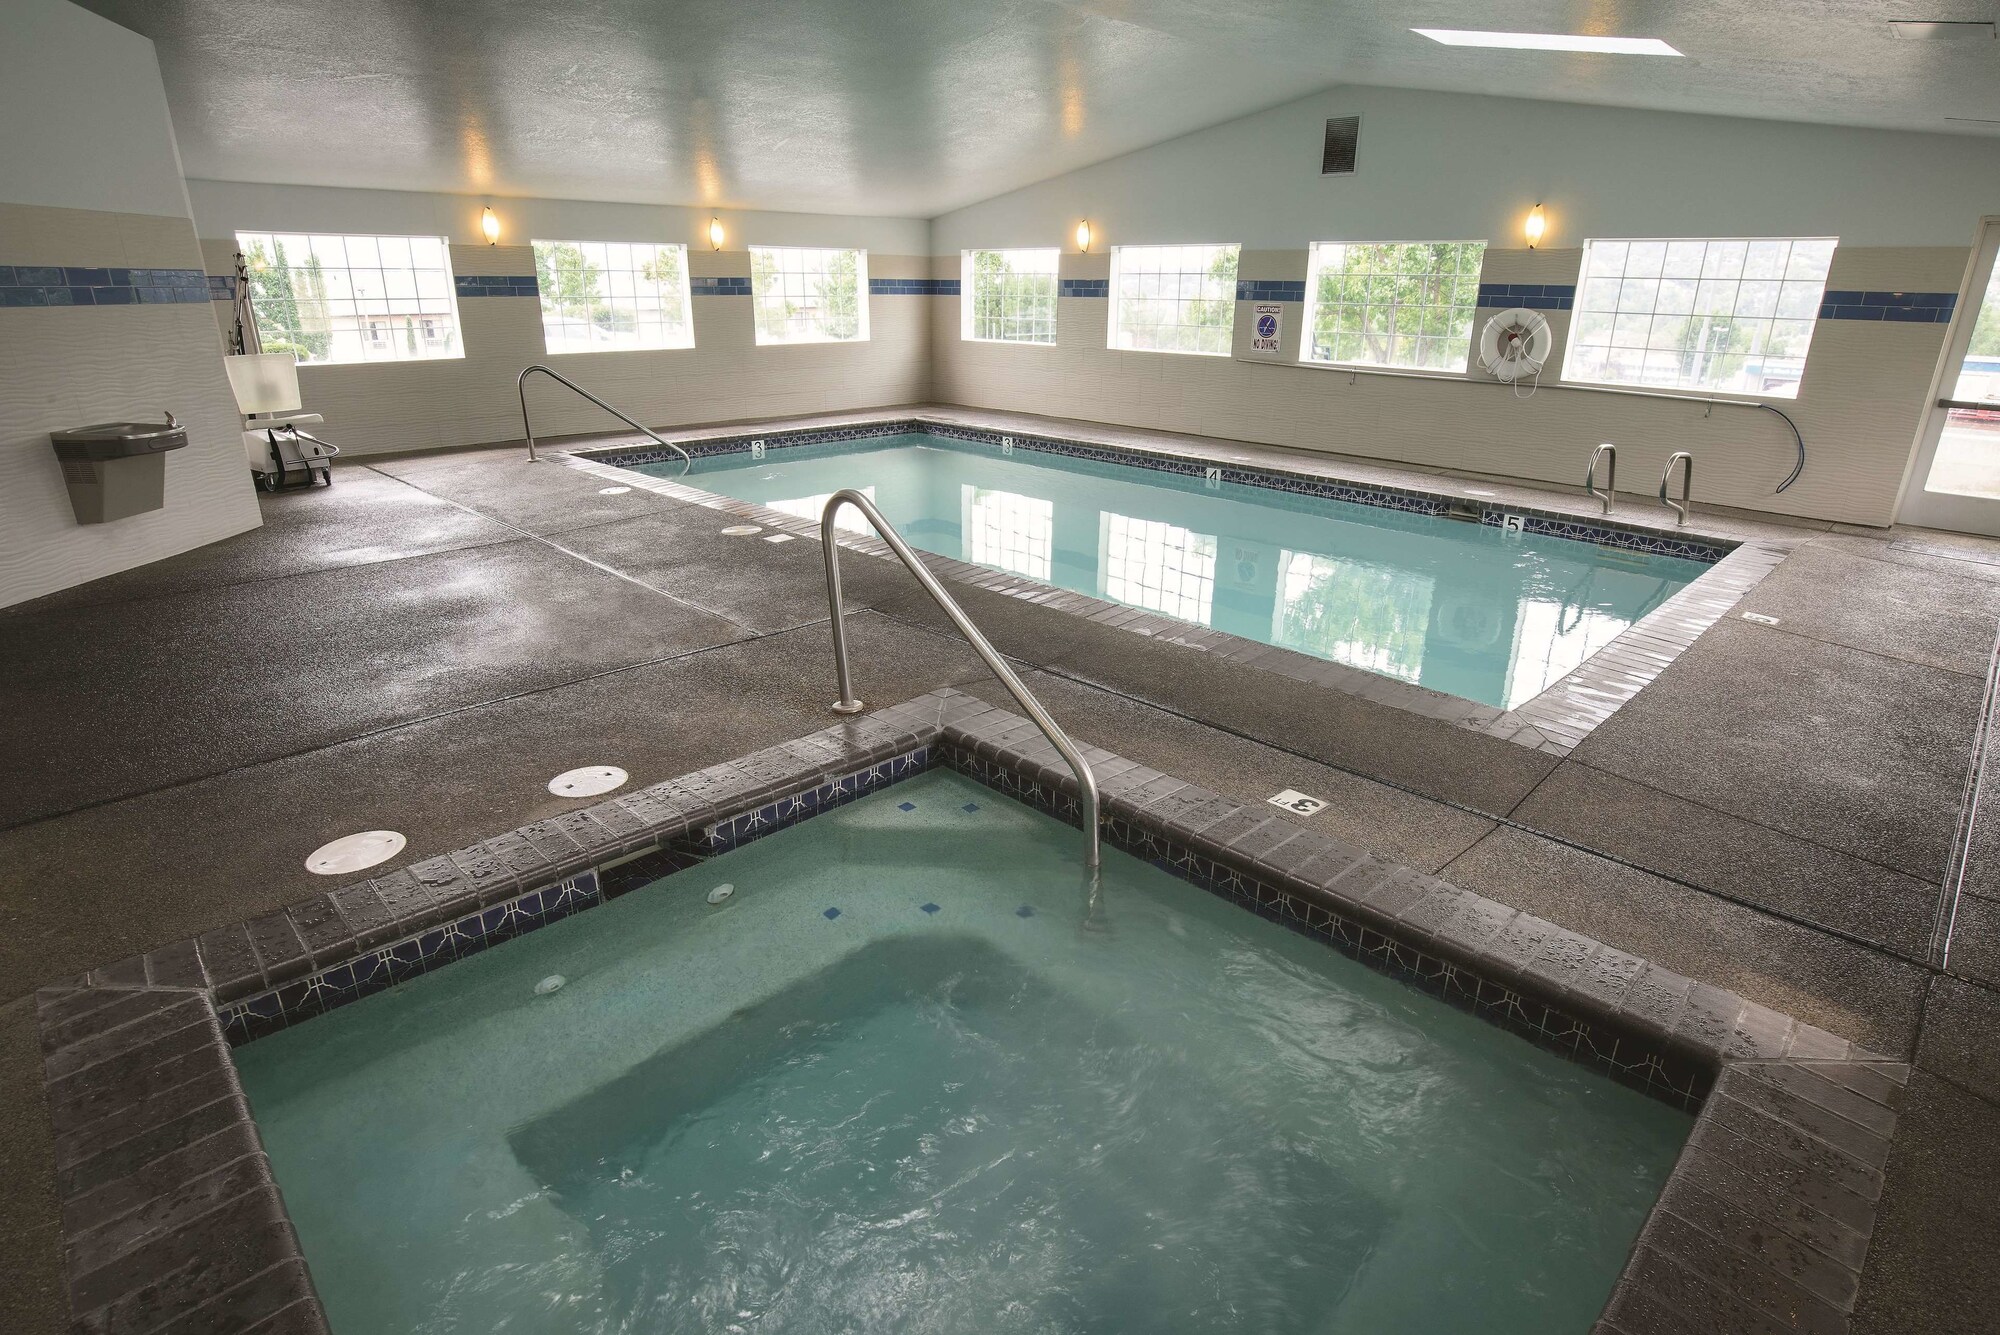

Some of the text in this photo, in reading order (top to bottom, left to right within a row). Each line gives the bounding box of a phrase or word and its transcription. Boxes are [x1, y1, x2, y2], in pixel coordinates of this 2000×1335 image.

[1253, 339, 1260, 349] NO
[755, 441, 762, 451] 3
[1005, 437, 1011, 447] 3
[1209, 469, 1217, 480] 4
[1508, 516, 1520, 531] 5
[1291, 798, 1320, 812] 3
